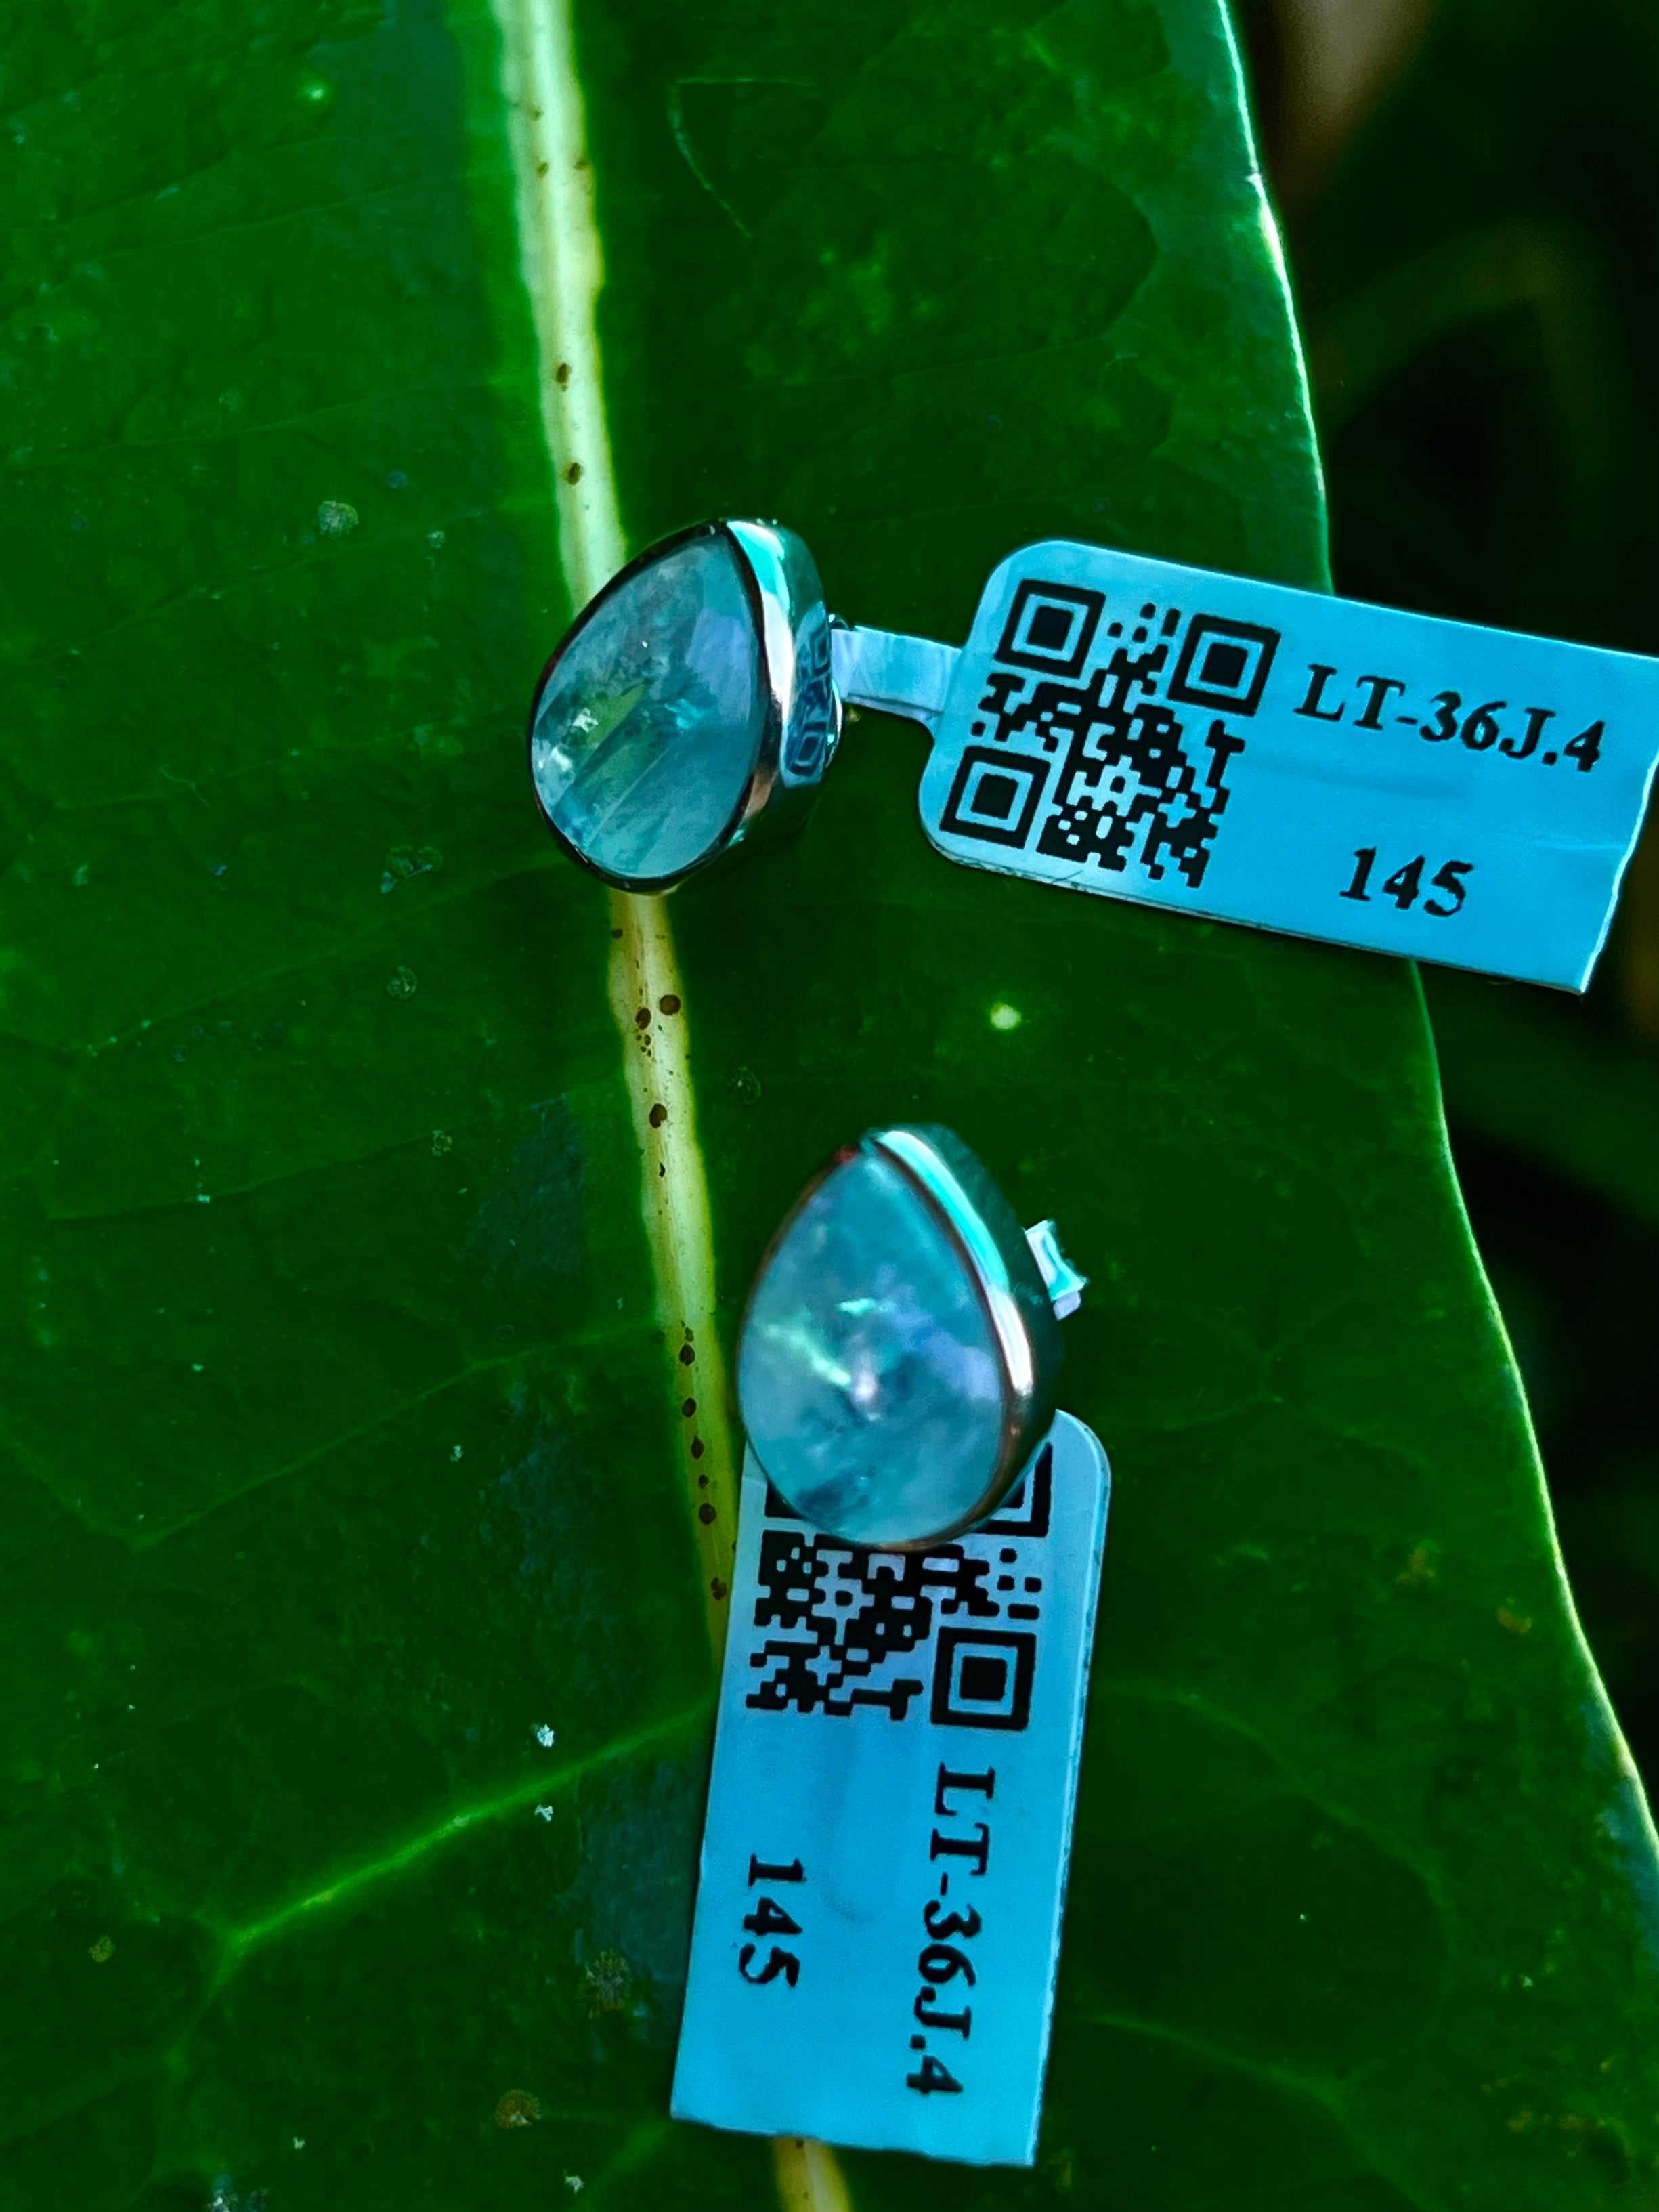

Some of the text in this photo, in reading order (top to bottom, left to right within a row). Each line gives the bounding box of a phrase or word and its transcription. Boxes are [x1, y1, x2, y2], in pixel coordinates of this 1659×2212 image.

[1294, 664, 1605, 773] LT-36J.4
[1339, 847, 1474, 917] 145
[739, 1854, 806, 1988] 145
[906, 1762, 996, 2096] LT-36J.4
